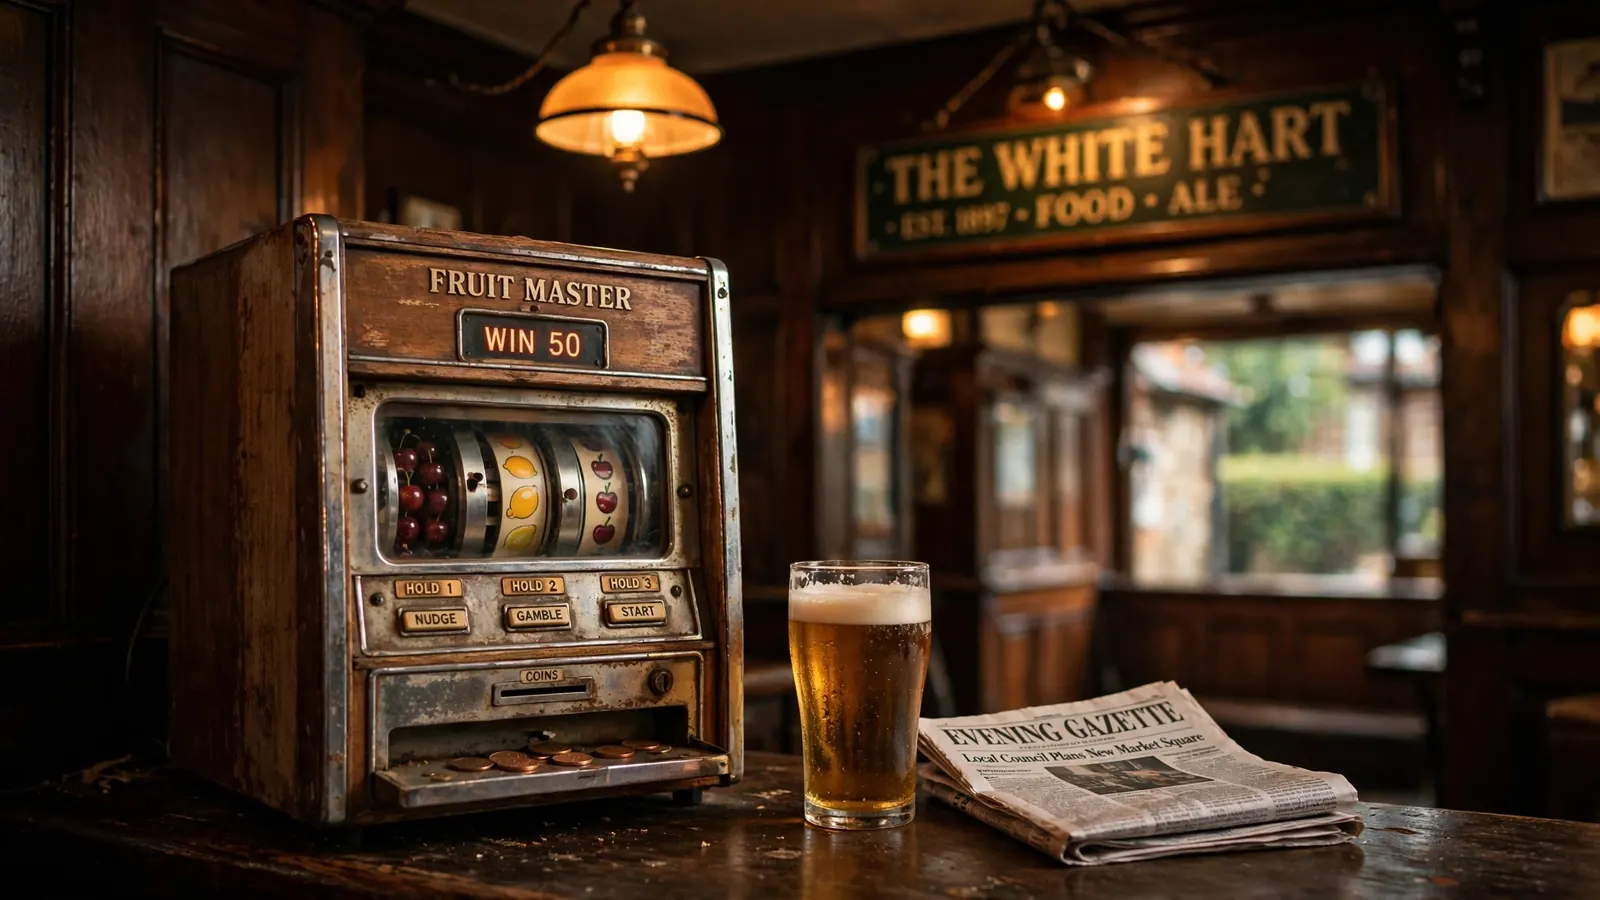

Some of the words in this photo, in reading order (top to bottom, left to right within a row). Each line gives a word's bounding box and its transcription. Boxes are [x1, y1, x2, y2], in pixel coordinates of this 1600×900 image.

[886, 145, 984, 203] THE
[994, 121, 1170, 190] WHITE
[1188, 101, 1352, 171] HART
[1035, 187, 1136, 229] FOOD
[1168, 175, 1243, 216] ALE
[429, 267, 514, 299] FRUIT
[524, 277, 632, 311] MASTER
[484, 326, 535, 354] WIN
[549, 332, 581, 357] 50
[405, 582, 440, 595] HOLD
[446, 582, 453, 594] 1
[511, 580, 543, 592] HOLD
[549, 580, 558, 592] 2
[609, 578, 640, 590] HOLD
[644, 577, 652, 589] 3
[516, 609, 563, 622] GAMBLE
[621, 605, 655, 617] START
[415, 613, 457, 625] NUDGE
[525, 670, 558, 682] COINS
[942, 722, 1062, 746] EVENING
[1063, 700, 1185, 740] GAZETTE
[962, 753, 999, 764] Local
[1000, 752, 1050, 763] Council
[1050, 750, 1085, 762] Plans
[1085, 747, 1115, 759] New
[1114, 740, 1162, 756] Market
[1159, 733, 1206, 749] Square
